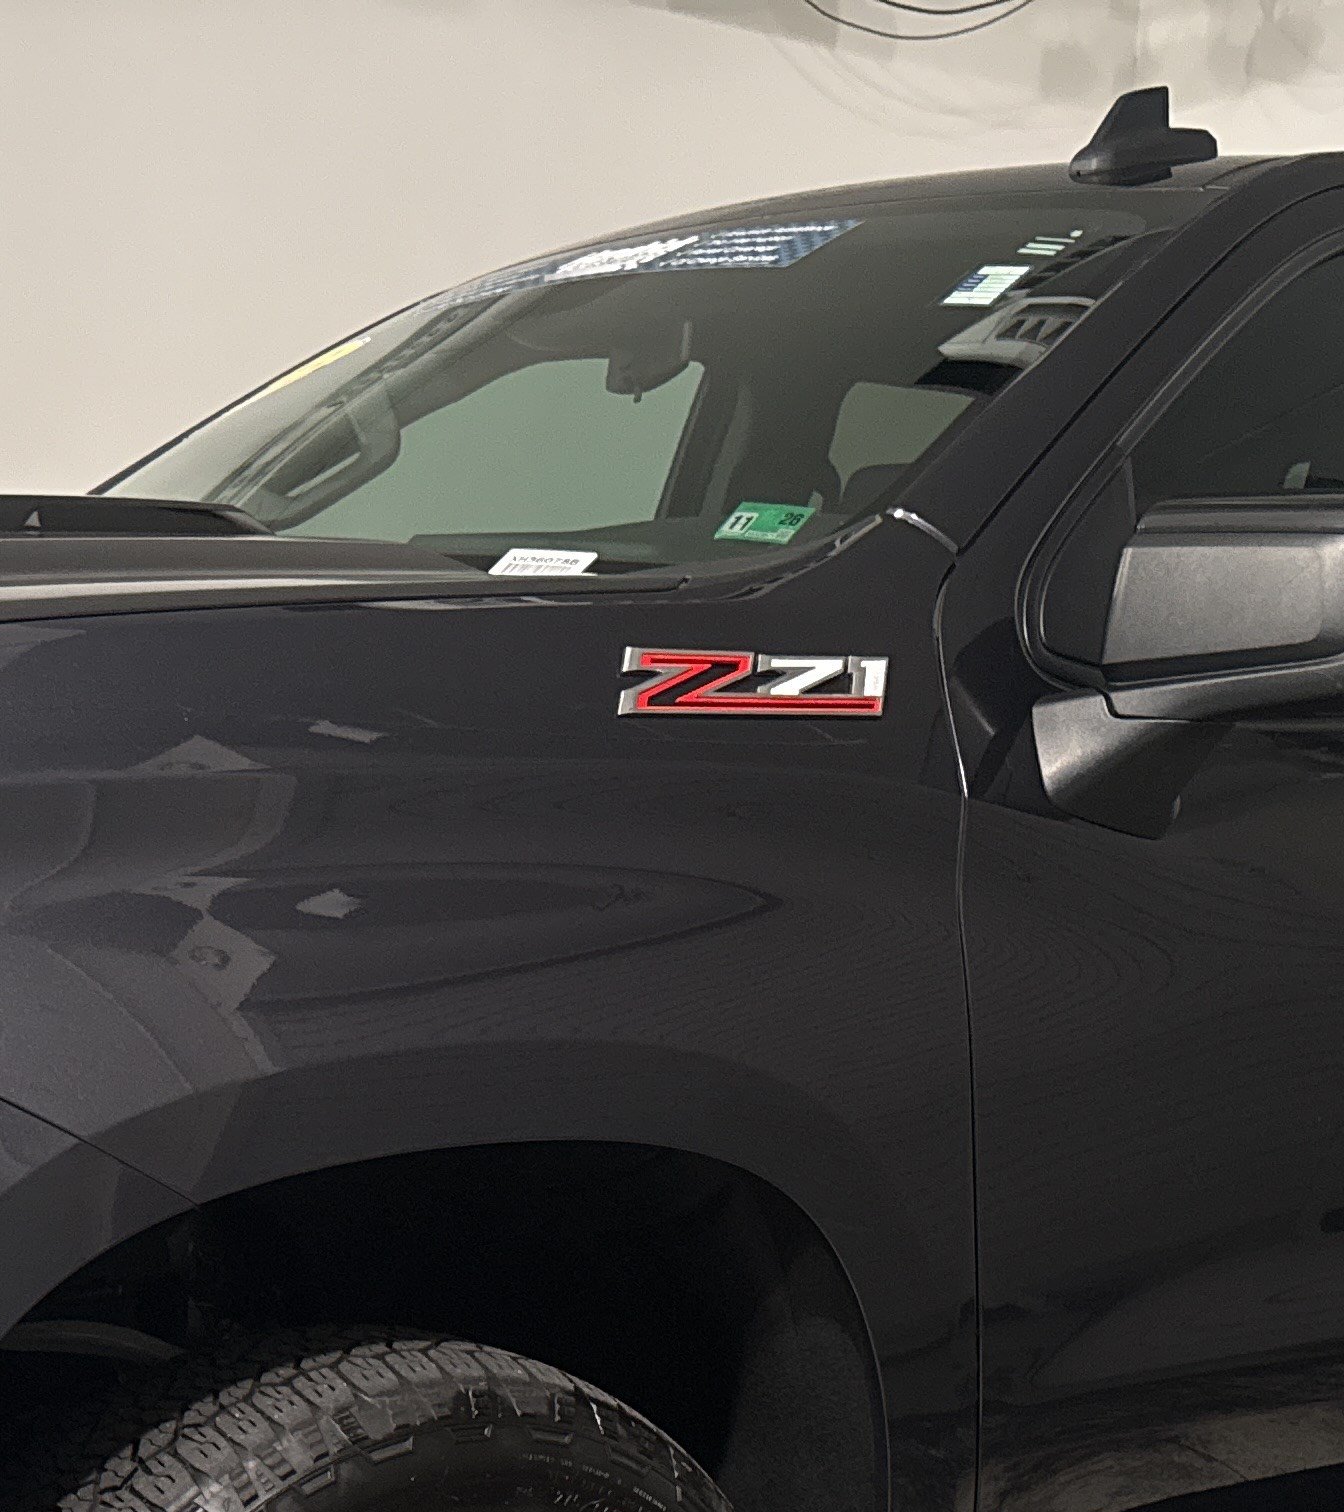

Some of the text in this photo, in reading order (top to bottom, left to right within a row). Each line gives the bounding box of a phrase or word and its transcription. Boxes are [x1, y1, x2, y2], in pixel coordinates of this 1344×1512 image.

[728, 511, 805, 532] 11 26
[617, 646, 889, 716] Z71
